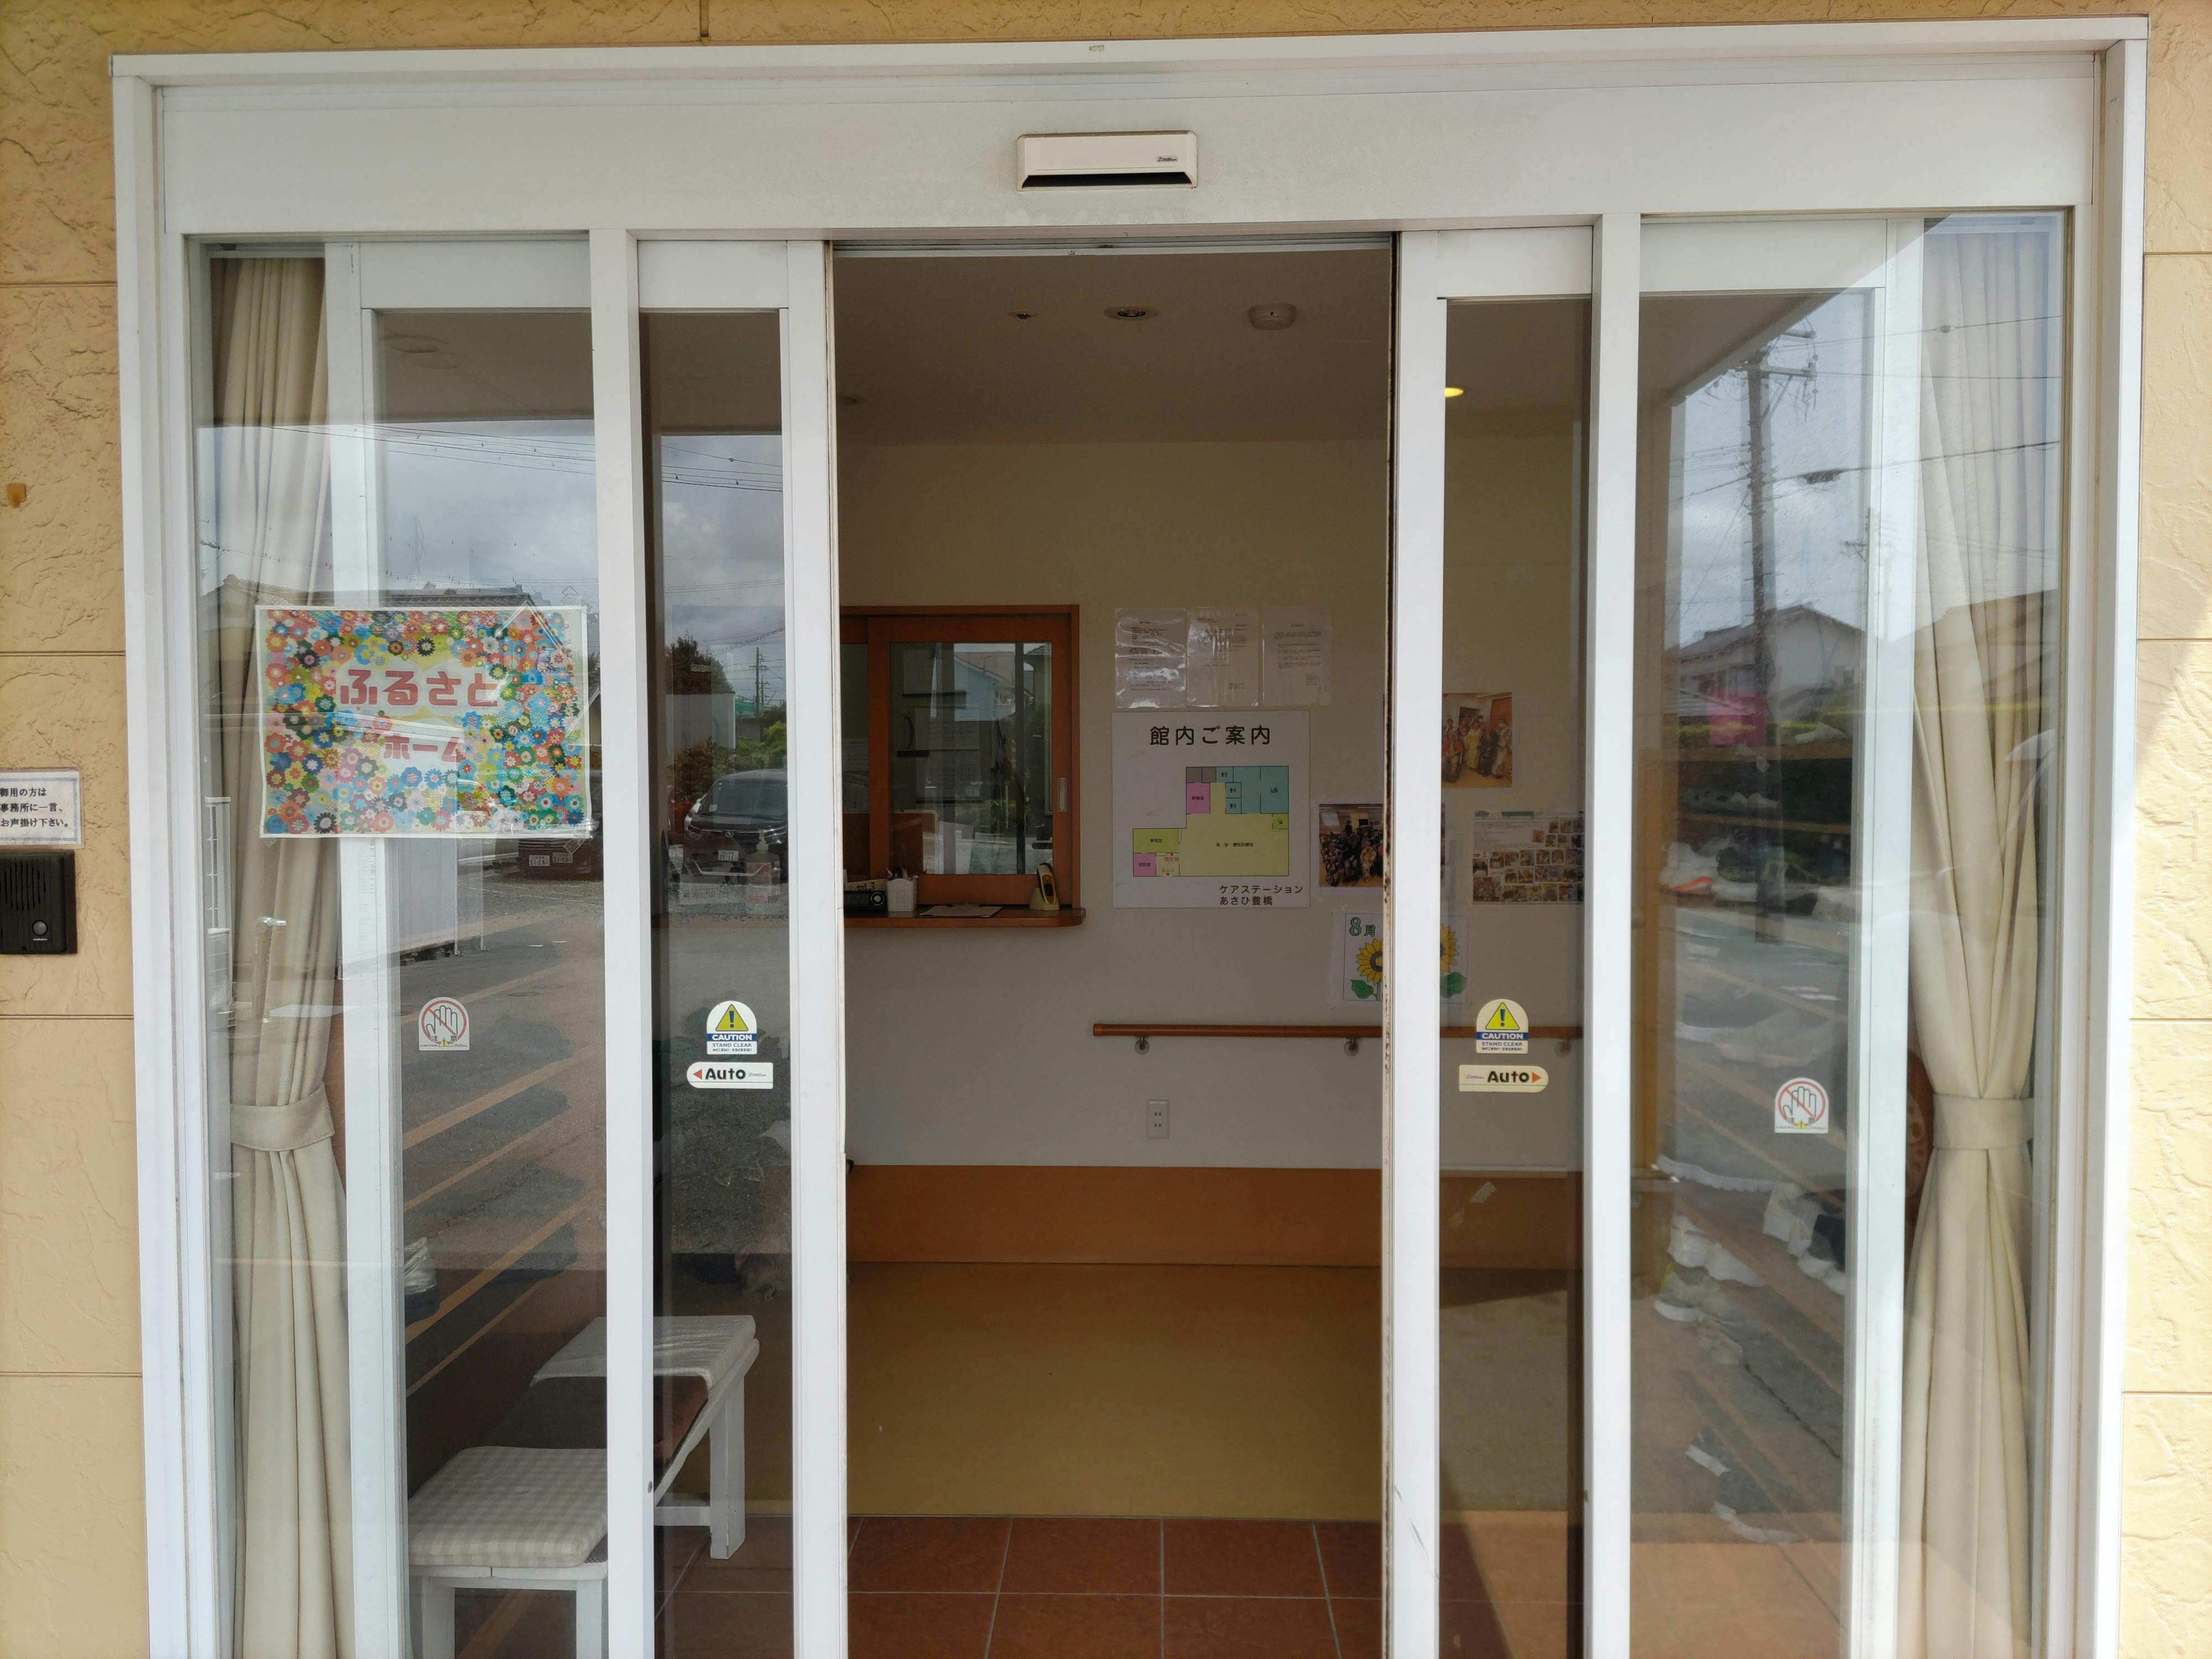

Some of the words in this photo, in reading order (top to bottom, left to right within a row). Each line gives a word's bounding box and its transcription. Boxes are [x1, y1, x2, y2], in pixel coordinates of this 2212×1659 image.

[340, 669, 498, 707] ふるさと
[1150, 726, 1270, 745] 館内ご案内
[383, 735, 466, 763] ホーム
[0, 803, 62, 812] 事務所に一言、
[1, 818, 68, 827] お声掛け下さい。
[1219, 885, 1303, 894] ケアステーション
[1220, 896, 1273, 906] あさひ豊橋
[1349, 917, 1376, 937] 8月
[705, 1068, 746, 1080] Auto
[1487, 1071, 1530, 1083] Auto
